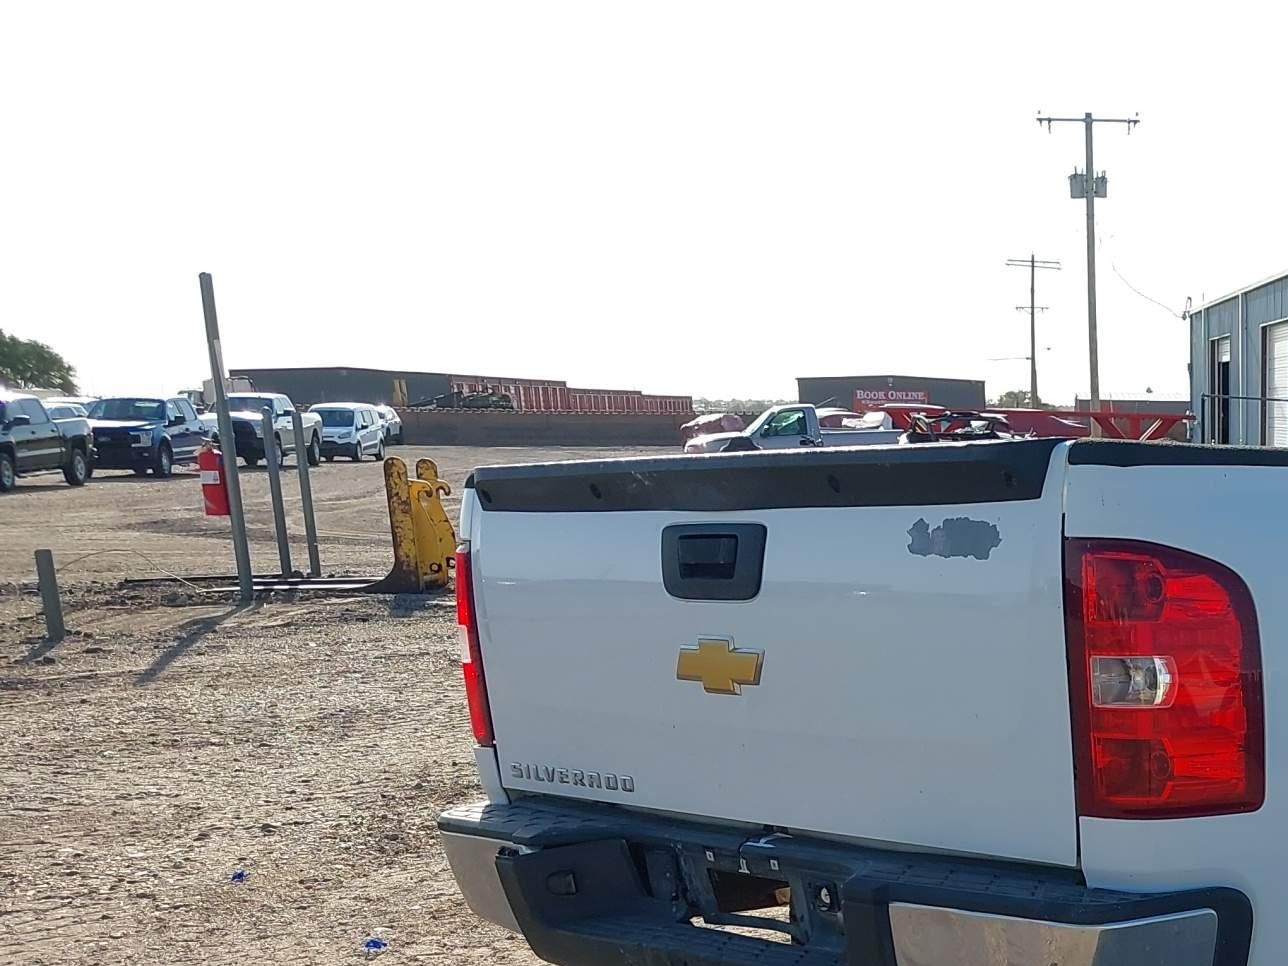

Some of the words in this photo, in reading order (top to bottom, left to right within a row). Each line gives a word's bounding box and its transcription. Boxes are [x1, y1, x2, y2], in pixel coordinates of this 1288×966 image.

[856, 390, 886, 400] BOOK
[888, 390, 925, 400] ONLINE
[511, 761, 635, 793] SILVERADO
